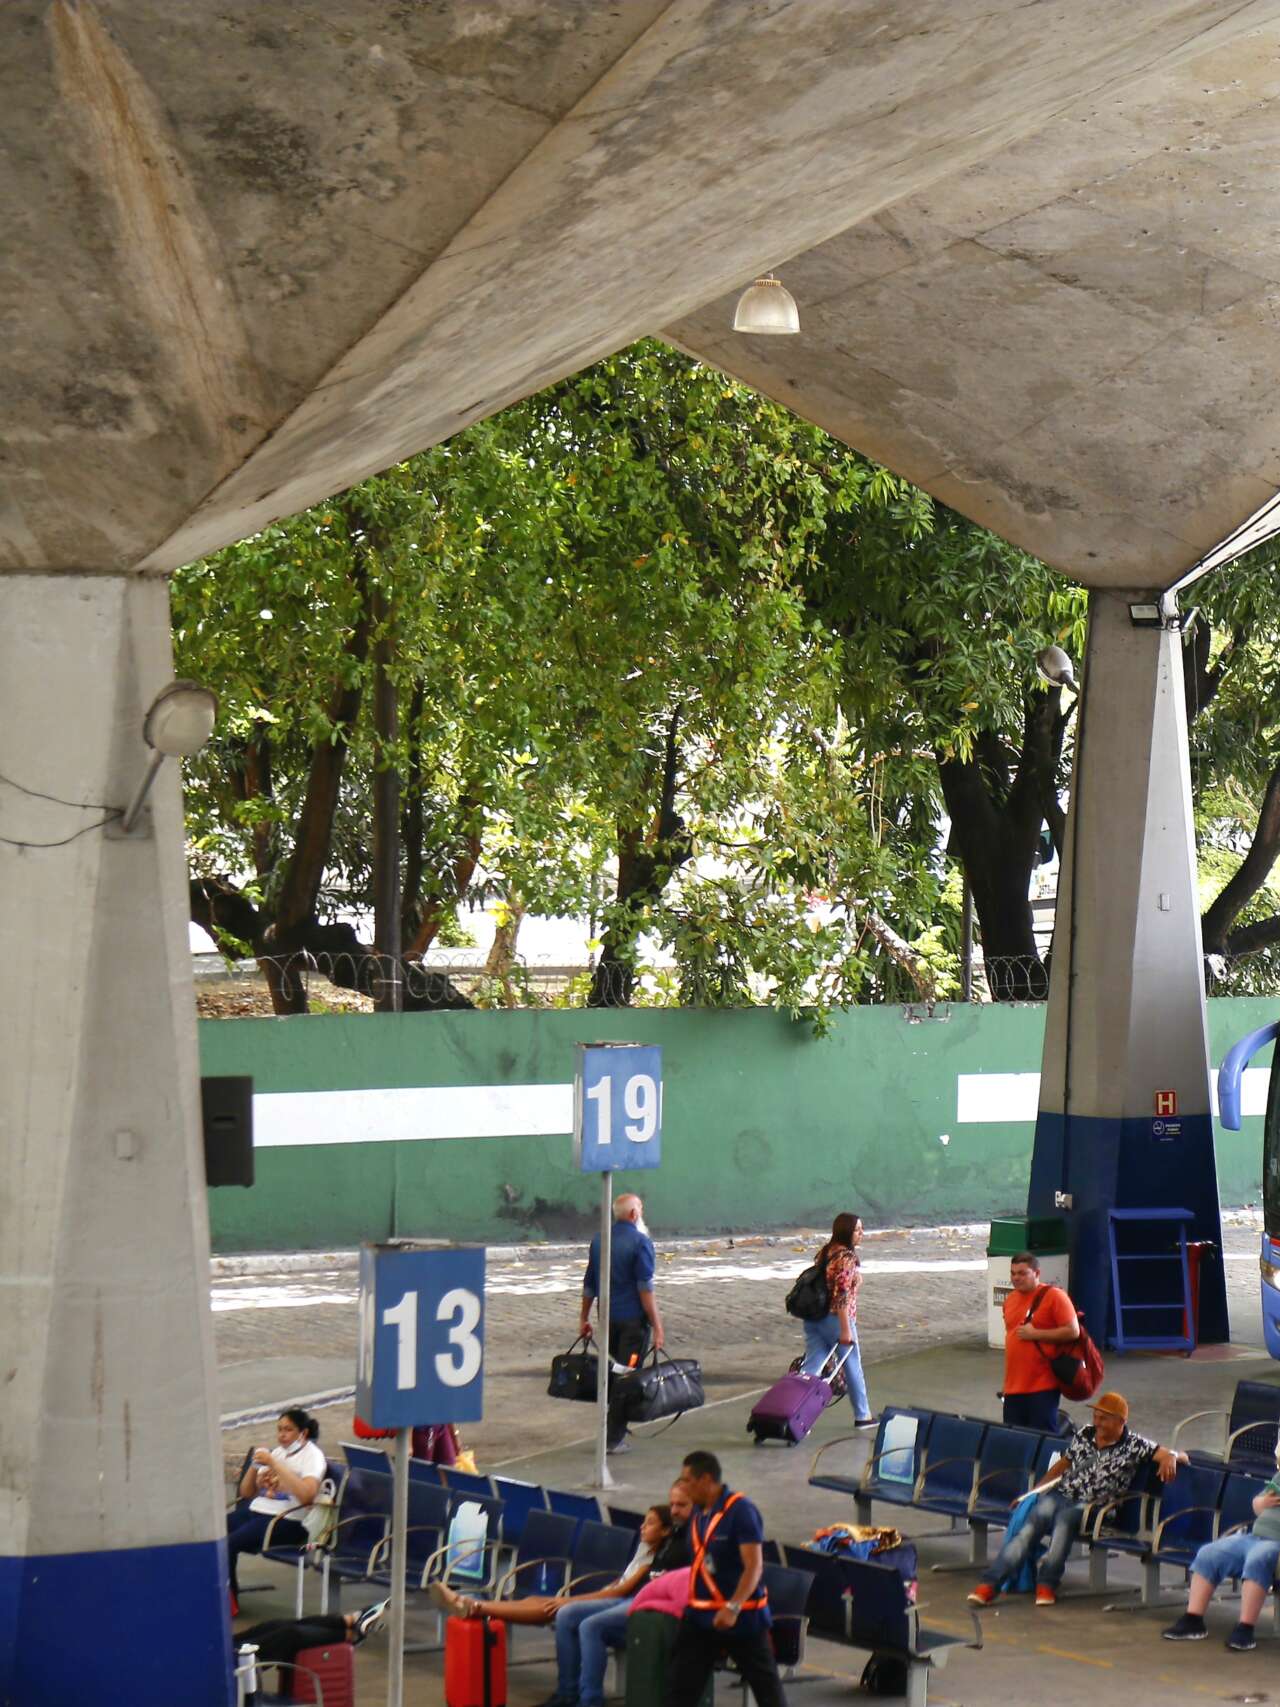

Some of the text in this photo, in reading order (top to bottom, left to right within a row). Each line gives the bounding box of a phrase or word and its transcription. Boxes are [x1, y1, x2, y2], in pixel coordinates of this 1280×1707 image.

[586, 1073, 658, 1145] 19
[1157, 1093, 1174, 1115] H
[382, 1287, 483, 1391] 13
